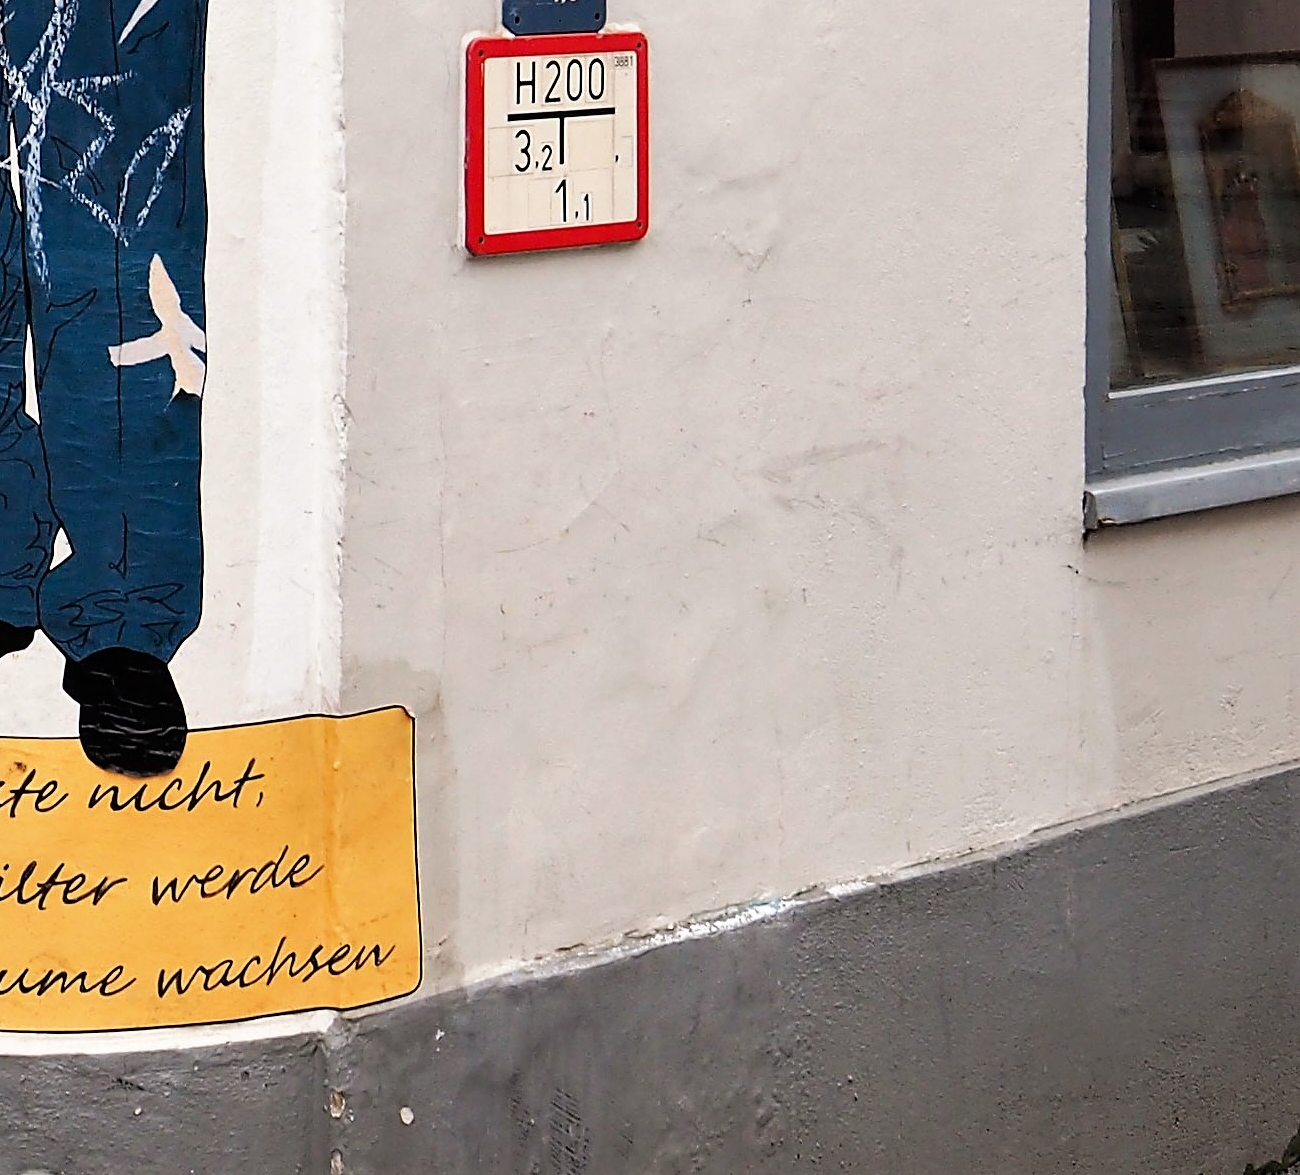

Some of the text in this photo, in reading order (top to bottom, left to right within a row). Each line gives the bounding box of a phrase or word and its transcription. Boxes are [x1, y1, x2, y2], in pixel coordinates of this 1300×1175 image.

[87, 757, 265, 812] nicht,
[151, 845, 324, 906] werde
[157, 936, 396, 998] wachsen
